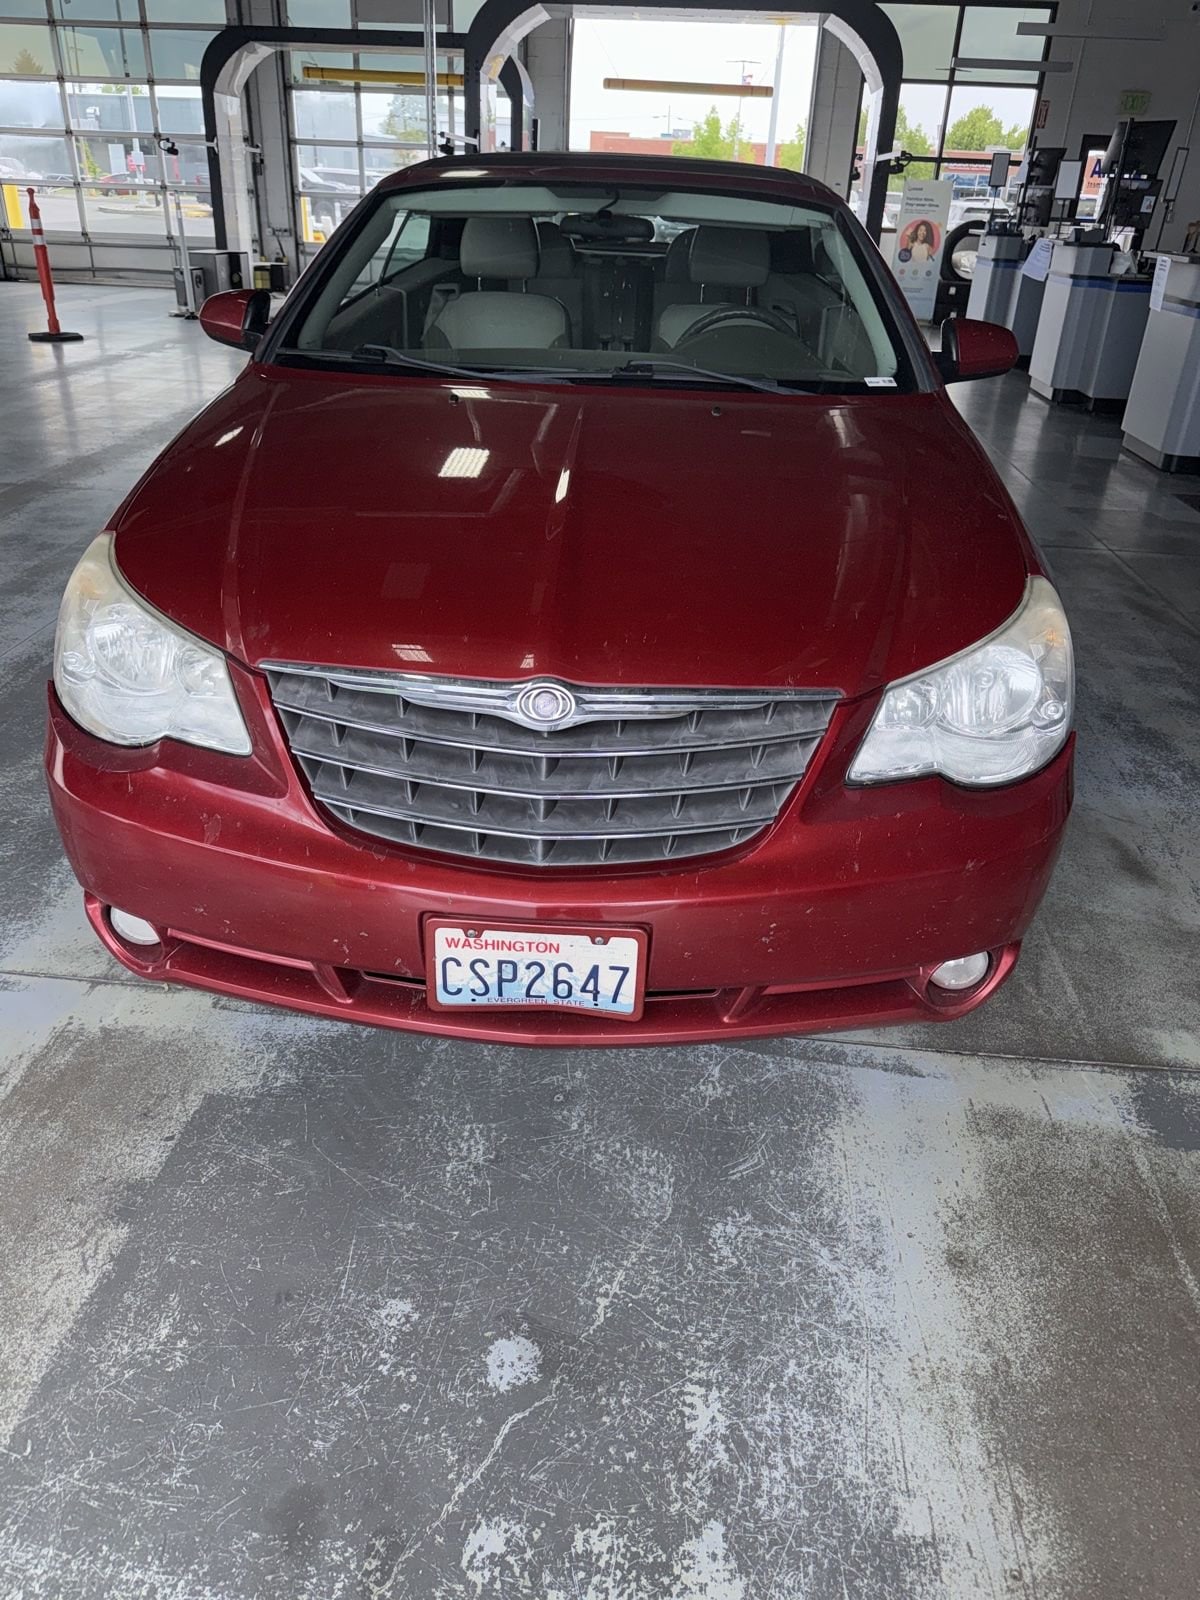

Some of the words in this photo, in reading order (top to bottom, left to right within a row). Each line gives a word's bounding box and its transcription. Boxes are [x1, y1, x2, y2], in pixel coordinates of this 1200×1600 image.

[445, 937, 560, 954] WASHINGTON
[441, 957, 630, 1004] CSP2647
[487, 997, 548, 1005] EVERGREEN
[553, 998, 585, 1007] STATE
